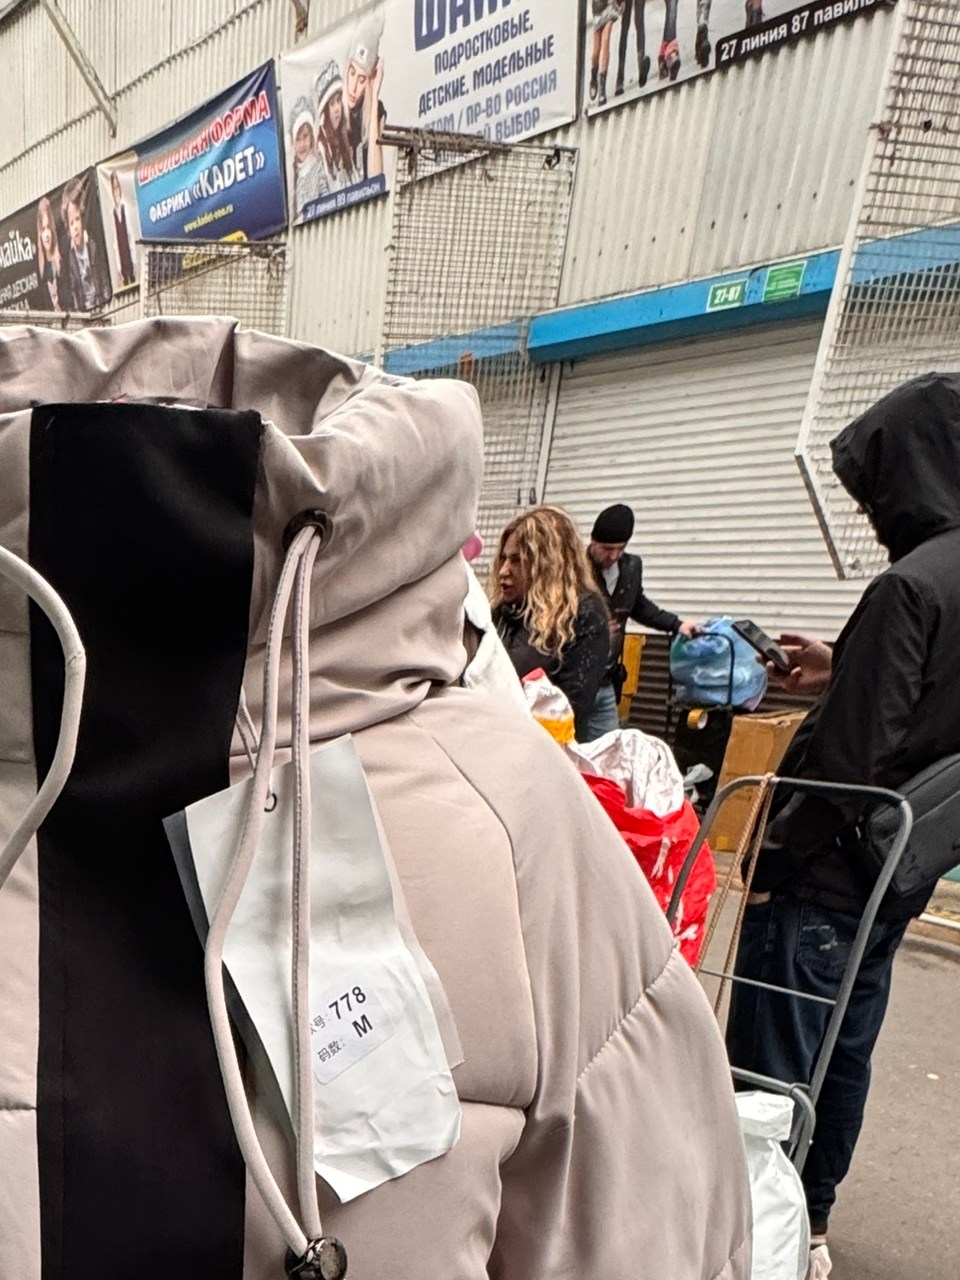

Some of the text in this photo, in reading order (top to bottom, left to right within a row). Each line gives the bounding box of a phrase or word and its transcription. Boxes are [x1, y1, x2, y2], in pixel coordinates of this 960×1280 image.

[472, 34, 554, 92] МОДЕЛЬНЫЕ
[720, 39, 738, 62] 27
[740, 23, 788, 56] линия
[791, 10, 809, 34] 87
[208, 90, 271, 149] ФОРМА
[466, 92, 502, 127] ПР-ВО
[505, 68, 557, 111] РОССИЯ
[495, 106, 540, 142] ВЫБОР
[149, 146, 265, 223] ФАБРИКА «KADET»
[328, 986, 366, 1020] 778
[351, 1014, 373, 1038] M
